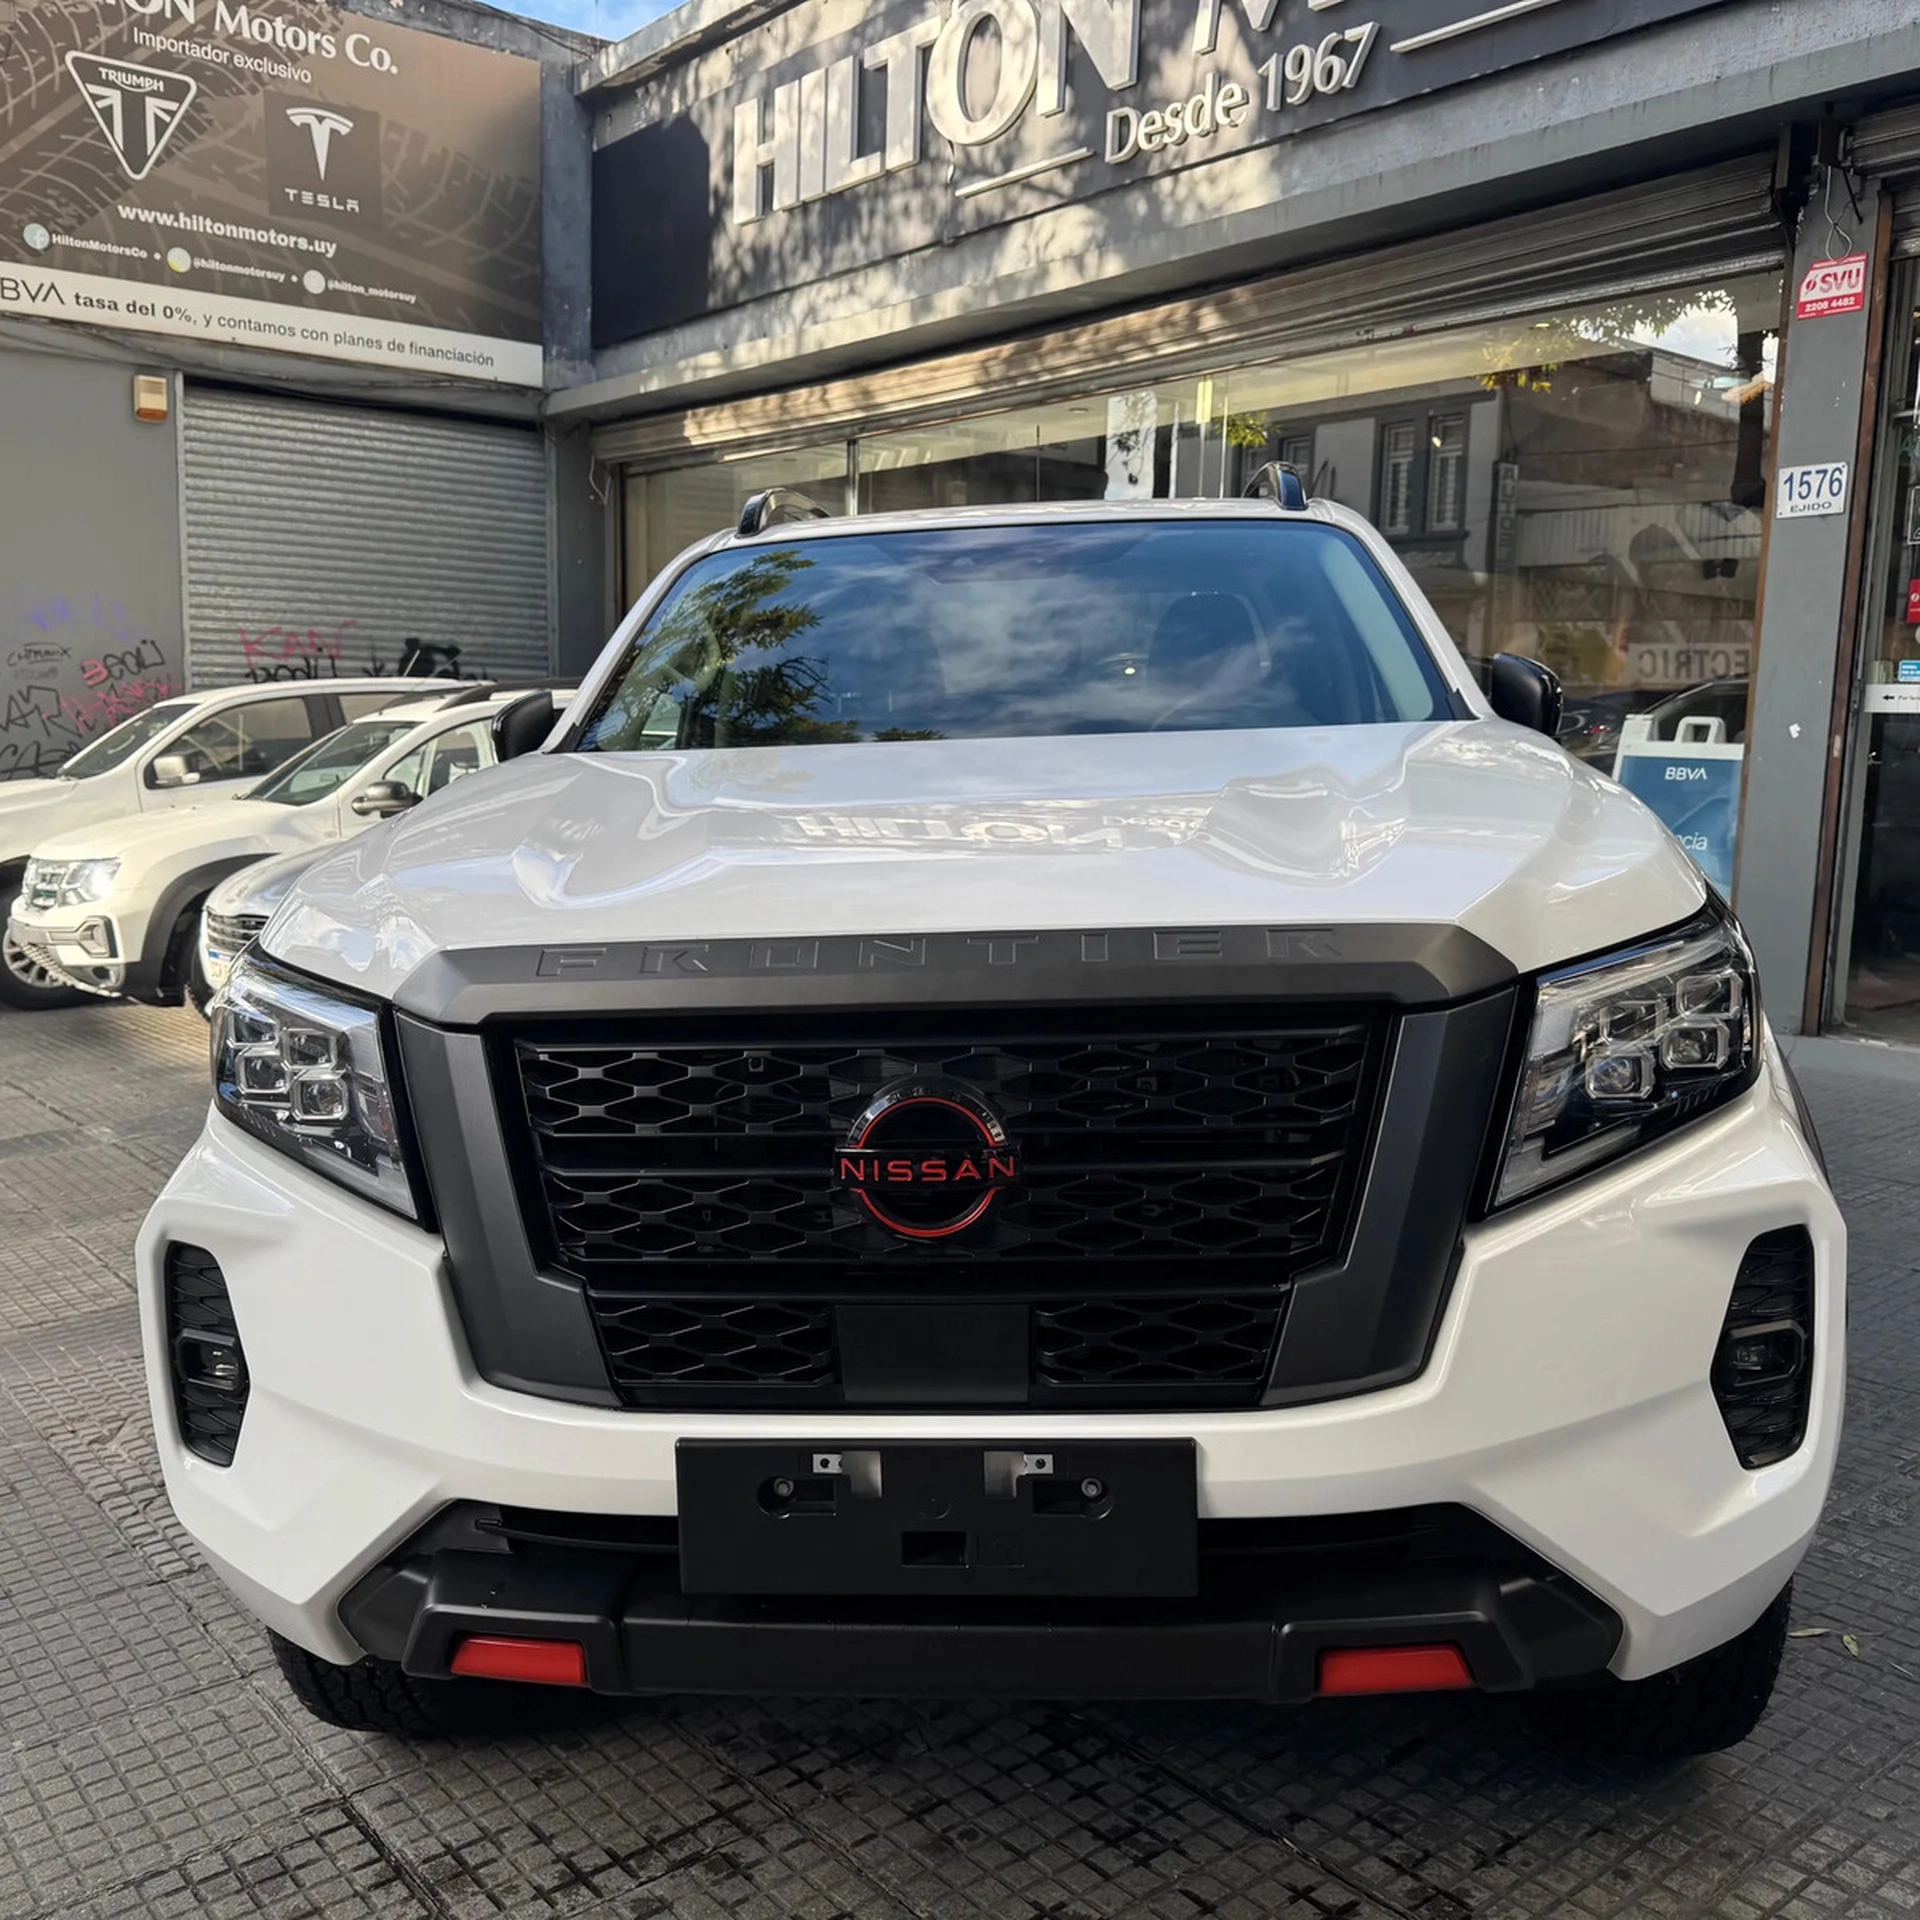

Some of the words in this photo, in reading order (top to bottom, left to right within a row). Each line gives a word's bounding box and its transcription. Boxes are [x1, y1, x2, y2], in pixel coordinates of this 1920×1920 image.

[214, 0, 337, 59] Motors
[345, 33, 399, 75] Co.
[133, 27, 229, 64] Importador
[233, 53, 312, 83] exclusivo
[98, 67, 164, 93] TRIUMPH
[1104, 72, 1250, 164] Desde
[1257, 21, 1380, 111] 1967
[733, 0, 1141, 226] HILTON
[285, 188, 360, 213] TESLA
[117, 204, 337, 258] www.hiltonmotors.uy
[52, 233, 148, 259] HiltonMotorsCo
[193, 256, 286, 283] @hiltonmotorsuy
[1820, 268, 1861, 293] SVU
[74, 291, 119, 312] tasa
[126, 300, 156, 317] del
[203, 313, 212, 328] y
[217, 315, 296, 337] contamos
[301, 328, 329, 343] con
[334, 333, 383, 351] planes
[387, 339, 405, 353] de
[409, 342, 494, 367] financiación
[1783, 467, 1843, 501] 1576
[1790, 501, 1832, 513] EJIDO
[1664, 766, 1708, 781] BBVA
[1676, 832, 1709, 851] cia
[536, 927, 1343, 977] FRONTIER
[840, 1155, 1015, 1182] NISSAN
